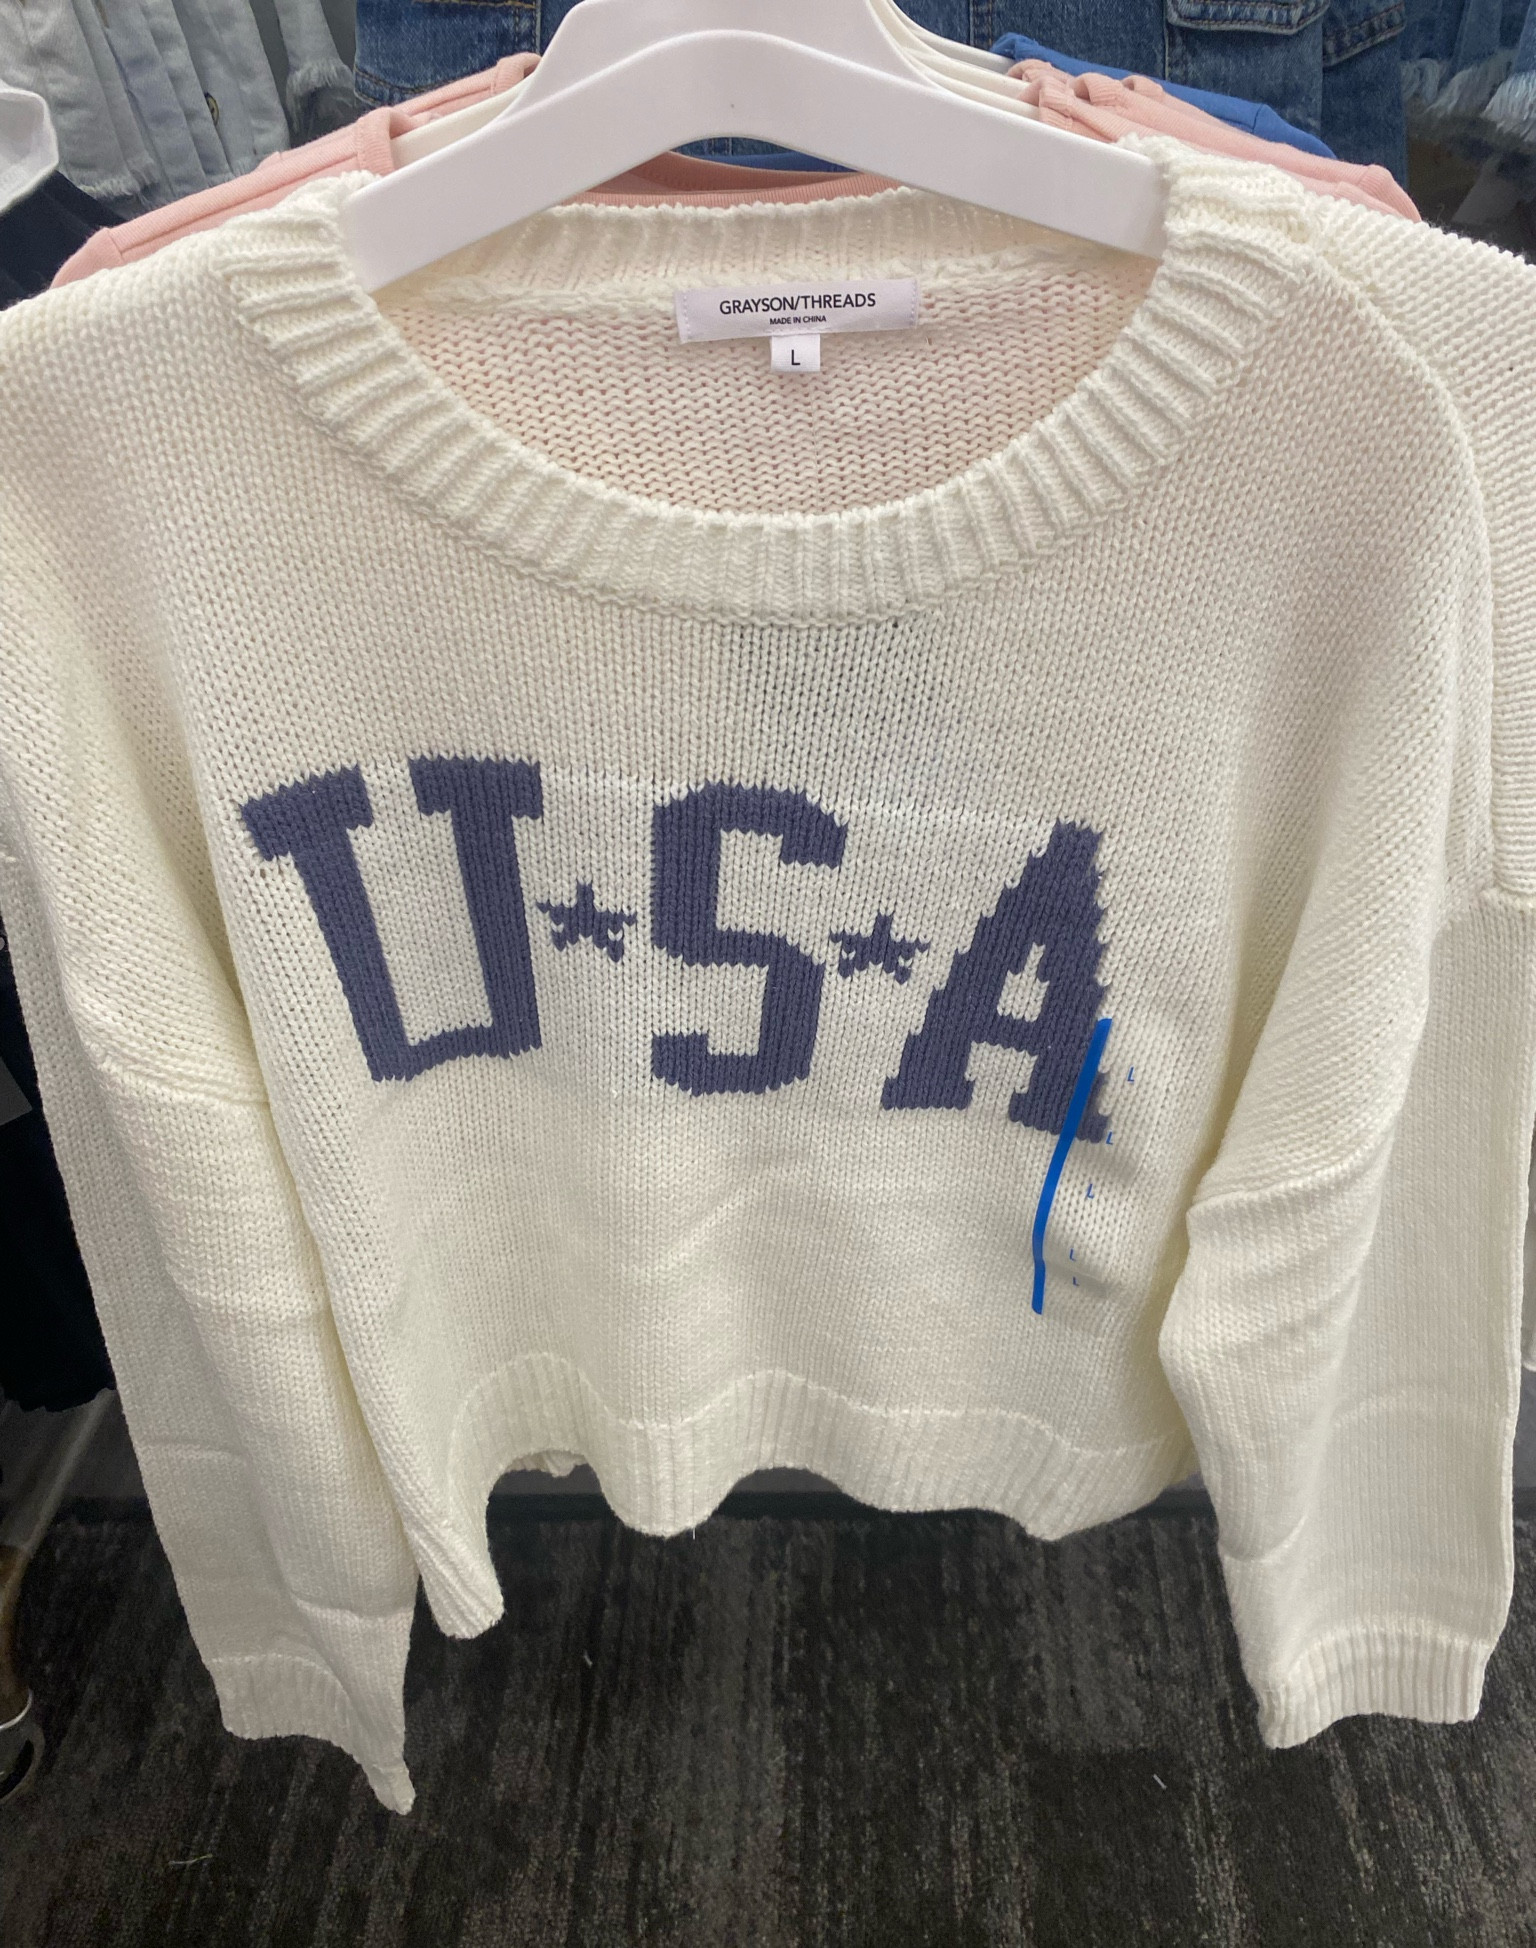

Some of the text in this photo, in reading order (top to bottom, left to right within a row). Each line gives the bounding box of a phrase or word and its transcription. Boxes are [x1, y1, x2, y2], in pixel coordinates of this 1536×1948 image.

[719, 292, 877, 315] GRAYSON/THREADS
[769, 315, 827, 325] MADE IN CHINA
[791, 349, 801, 366] L
